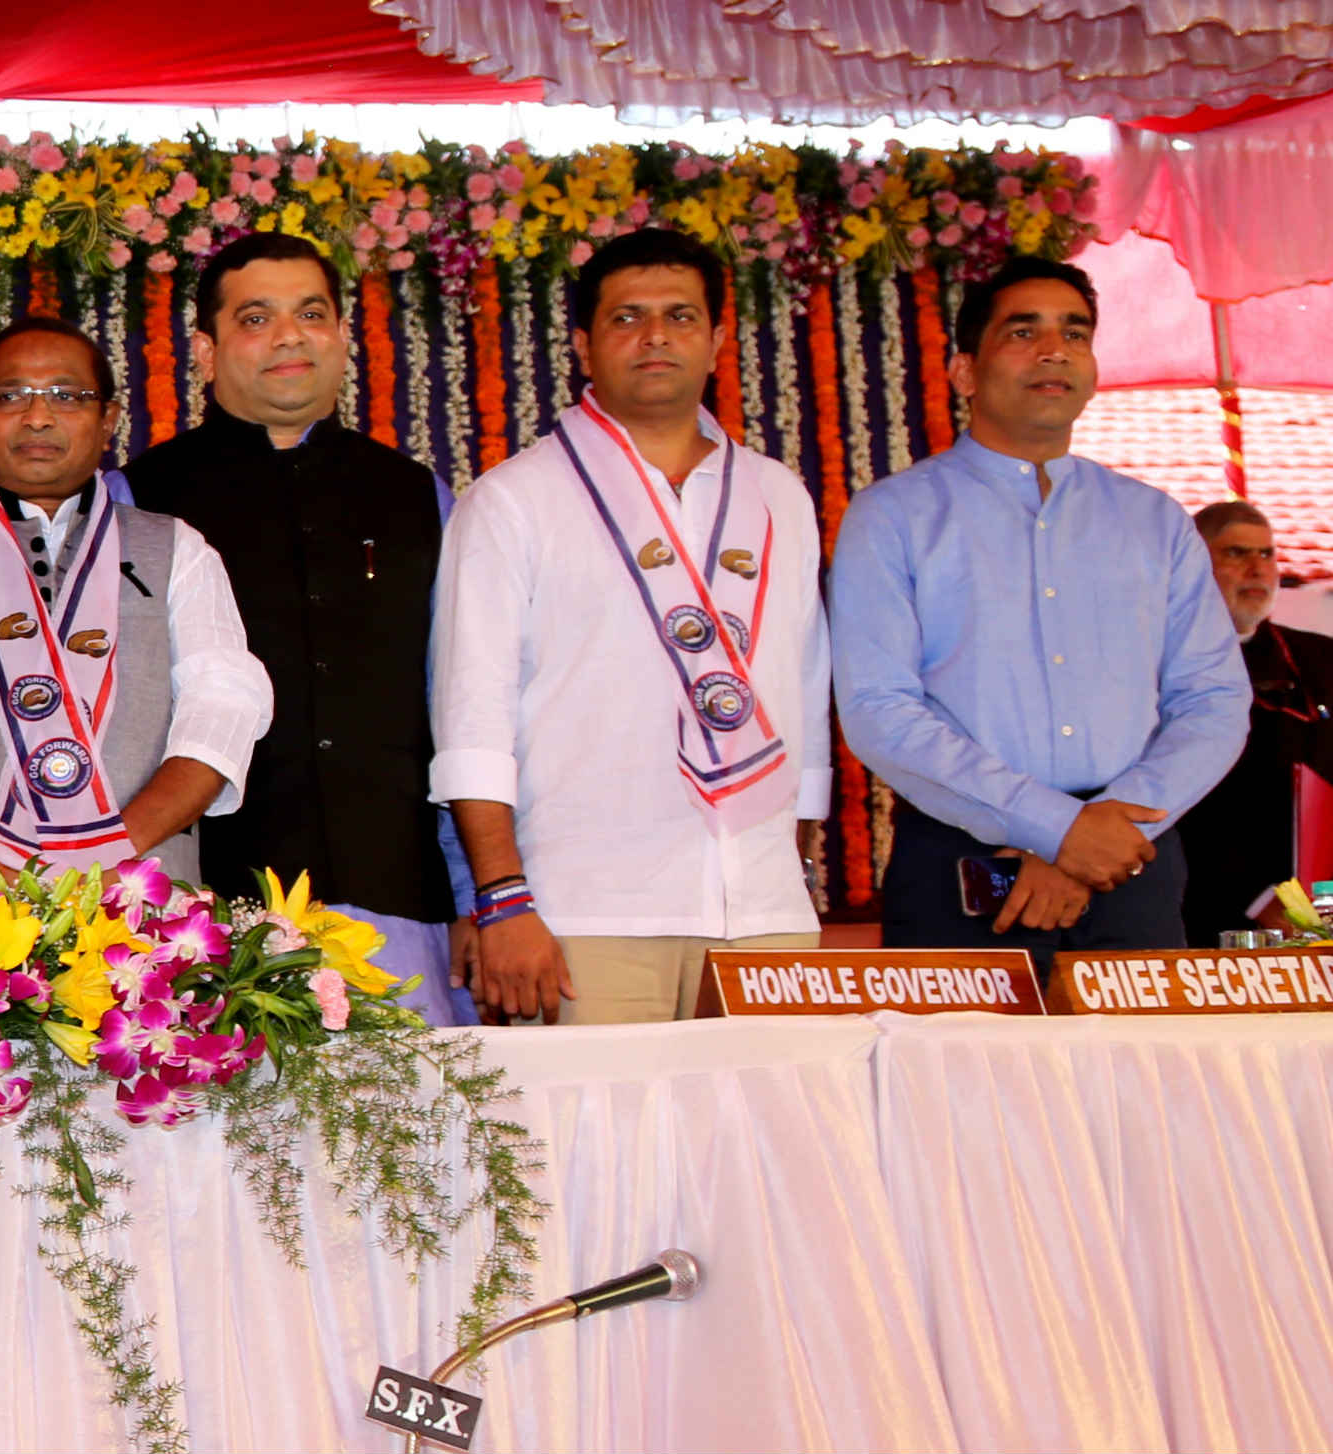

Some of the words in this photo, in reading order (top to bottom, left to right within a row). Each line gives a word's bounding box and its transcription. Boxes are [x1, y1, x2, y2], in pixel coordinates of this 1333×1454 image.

[701, 674, 750, 697] FORWARD
[29, 758, 41, 779] GOA
[39, 741, 90, 765] FORWARD
[738, 961, 863, 1005] HON'BLE
[865, 967, 1020, 1005] GOVERNOR
[1073, 960, 1171, 1010] CHIEF
